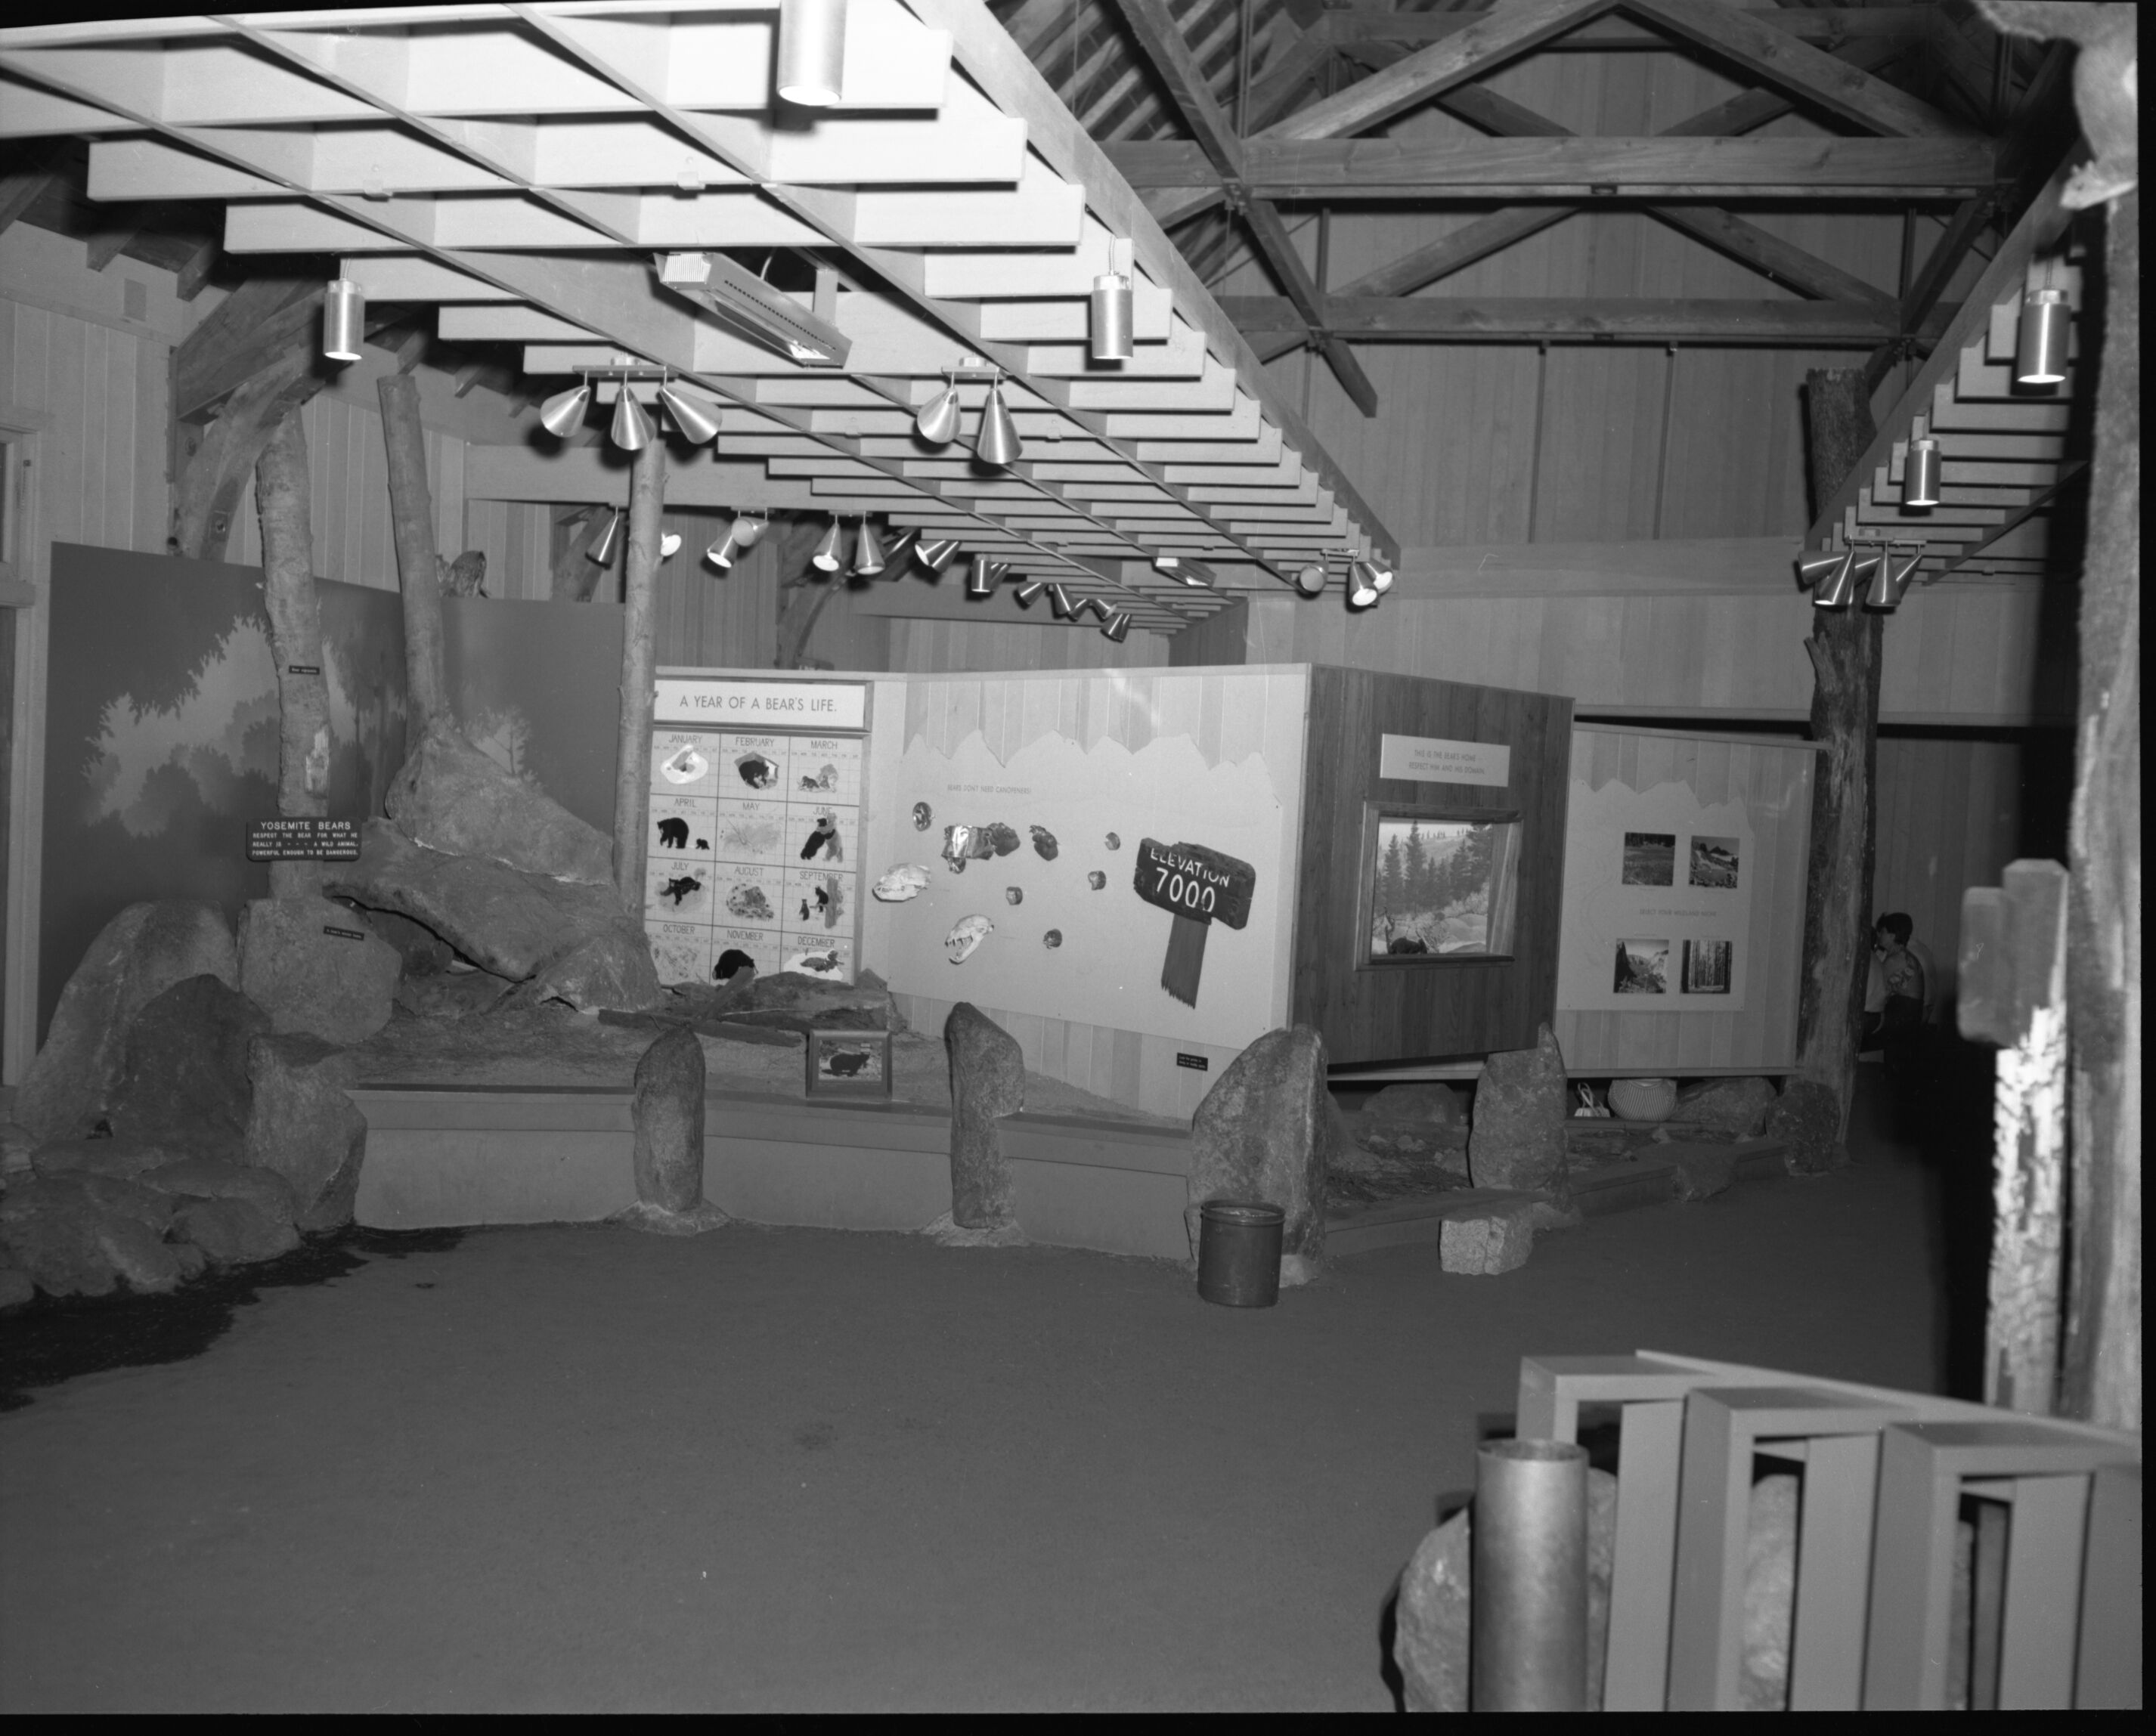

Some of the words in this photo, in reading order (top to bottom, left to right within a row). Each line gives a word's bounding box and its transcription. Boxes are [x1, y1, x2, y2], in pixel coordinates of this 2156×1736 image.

[680, 695, 688, 707] A
[694, 696, 722, 708] YEAR
[729, 696, 745, 709] OF
[751, 697, 760, 709] A
[766, 698, 804, 710] BEAR'S
[811, 698, 837, 712] LIFE.
[668, 735, 703, 744] JANUARY
[736, 737, 774, 747] FEBRUARY
[810, 741, 838, 750] MARCH
[1461, 754, 1476, 762] HOME
[674, 798, 696, 808] APRIL
[742, 802, 760, 811] MAY
[813, 806, 832, 815] JUNE
[261, 822, 311, 830] YOSEMITE
[318, 822, 351, 830] BEARS
[671, 862, 689, 871] JULY
[1151, 847, 1231, 888] ELEVATION
[734, 867, 764, 877] AUGUST
[799, 871, 844, 882] SEPTEMBER
[1156, 867, 1216, 912] 7000
[663, 924, 695, 935] OCTOBER
[727, 930, 764, 941] NOVEMBER
[798, 936, 835, 947] DECEMBER
